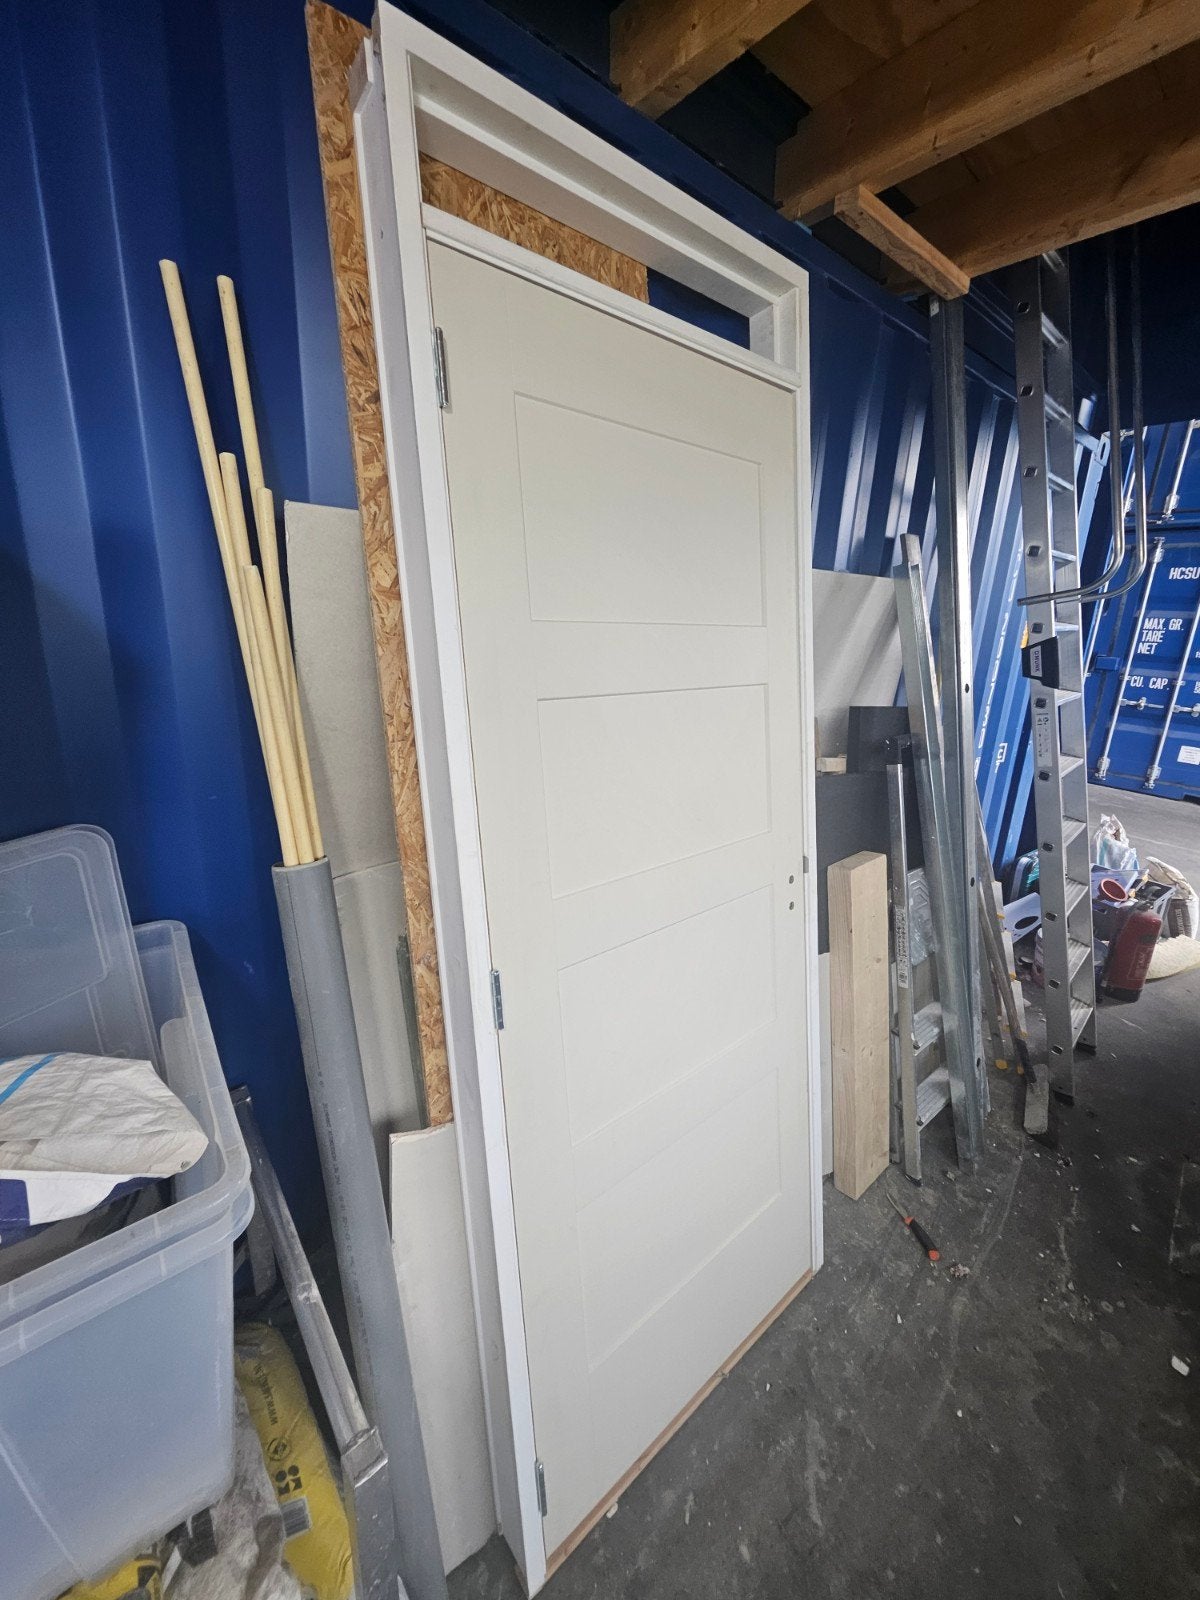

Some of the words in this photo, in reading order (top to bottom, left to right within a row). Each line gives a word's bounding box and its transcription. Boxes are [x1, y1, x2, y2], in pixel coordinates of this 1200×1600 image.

[1169, 567, 1200, 580] HCSU
[1143, 618, 1166, 631] MAX.
[1169, 618, 1184, 631] GR.
[1141, 630, 1164, 642] TARE
[1138, 643, 1157, 655] NET
[1130, 675, 1144, 688] CU.
[1149, 678, 1170, 690] CAP.
